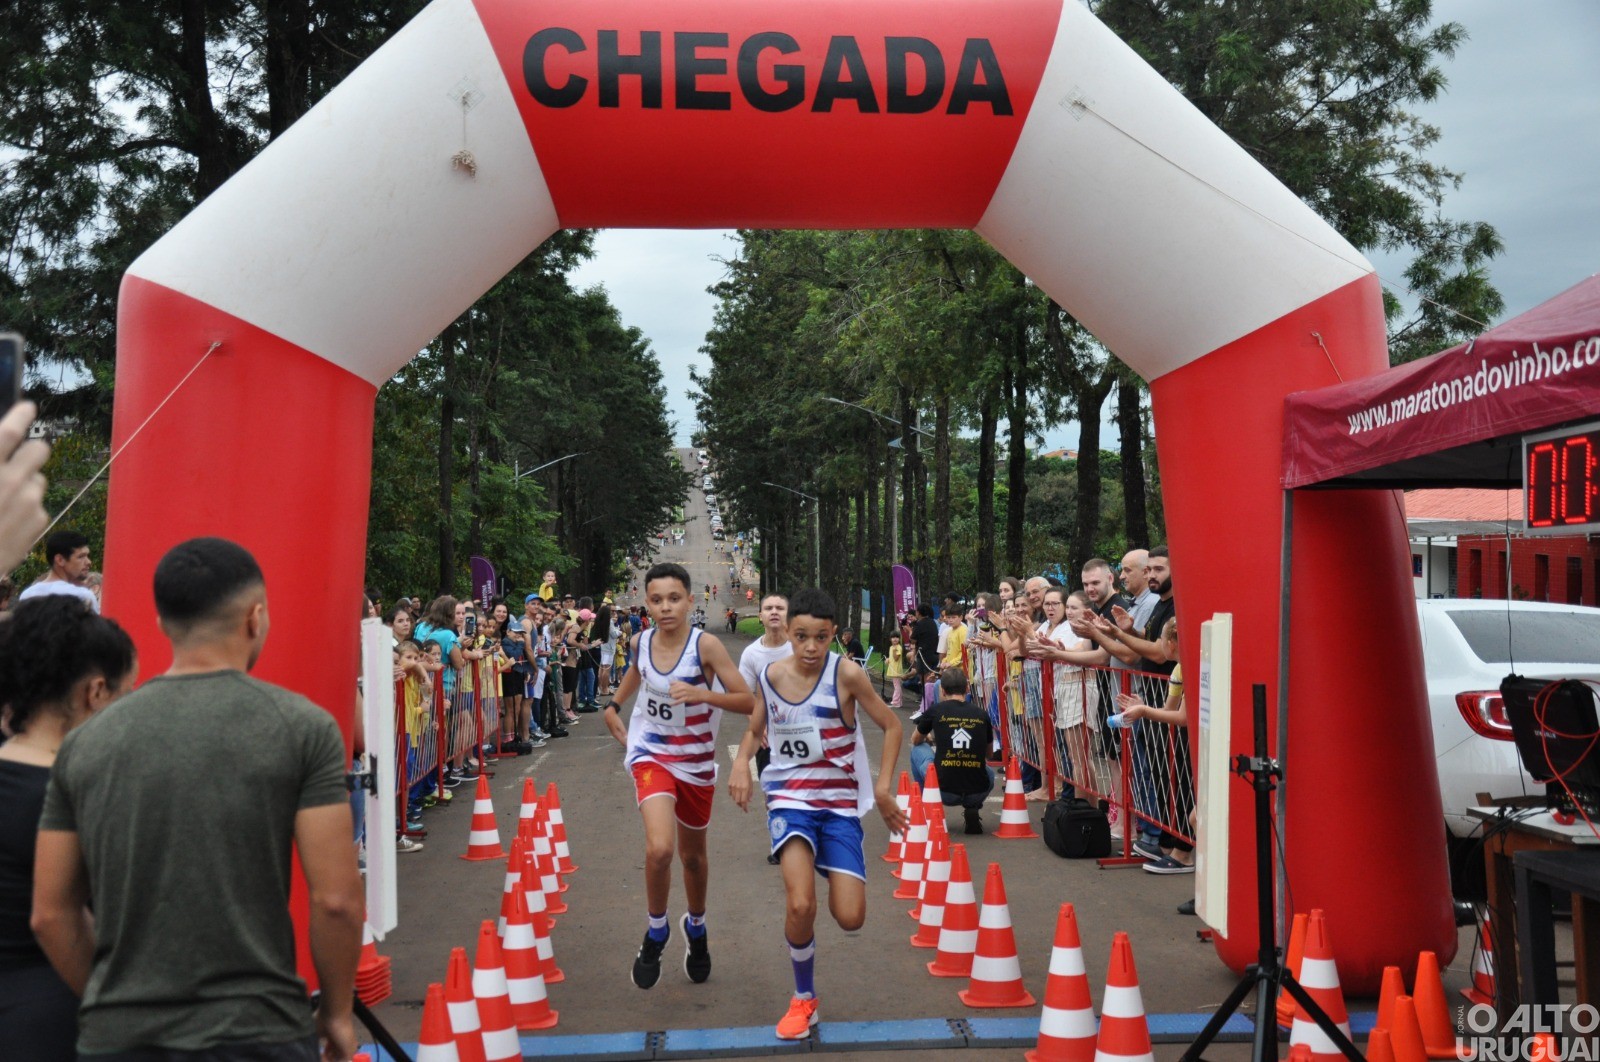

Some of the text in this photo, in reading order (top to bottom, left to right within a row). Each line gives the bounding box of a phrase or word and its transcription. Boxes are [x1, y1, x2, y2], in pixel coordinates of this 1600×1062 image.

[522, 27, 1014, 116] CHEGADA
[646, 698, 673, 720] 56
[779, 740, 810, 758] 49
[940, 759, 962, 767] PONTO
